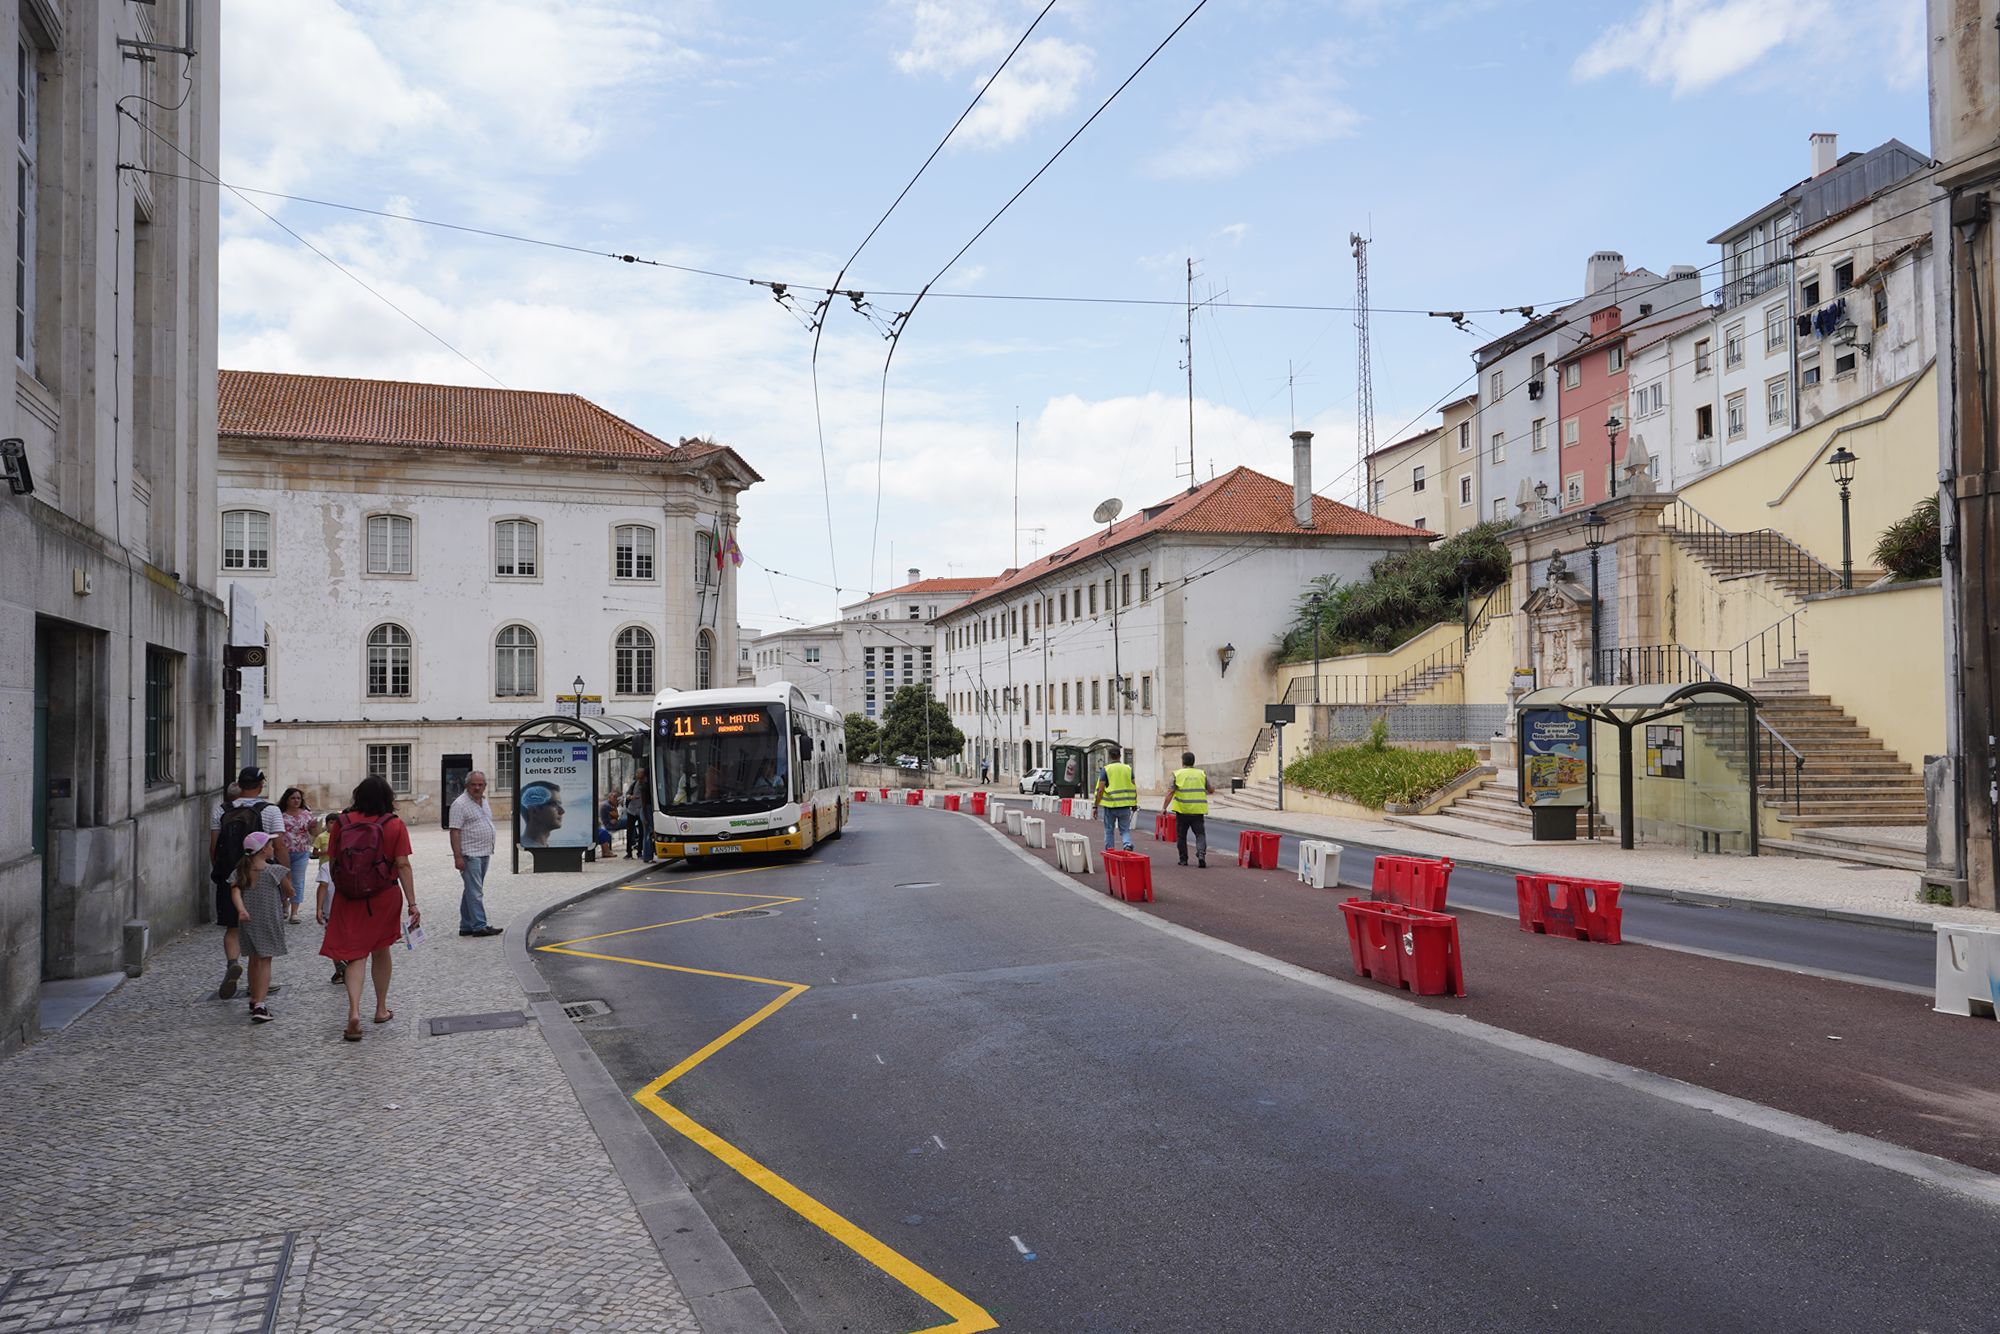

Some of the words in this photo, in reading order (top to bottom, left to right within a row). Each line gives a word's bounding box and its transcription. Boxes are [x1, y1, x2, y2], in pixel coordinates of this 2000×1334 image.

[701, 716, 711, 725] B.
[715, 715, 725, 724] N.
[729, 713, 760, 723] MATOS
[674, 716, 695, 736] 11
[525, 747, 563, 755] Descanse
[532, 755, 565, 763] cérebro!
[553, 766, 577, 774] ZEISS
